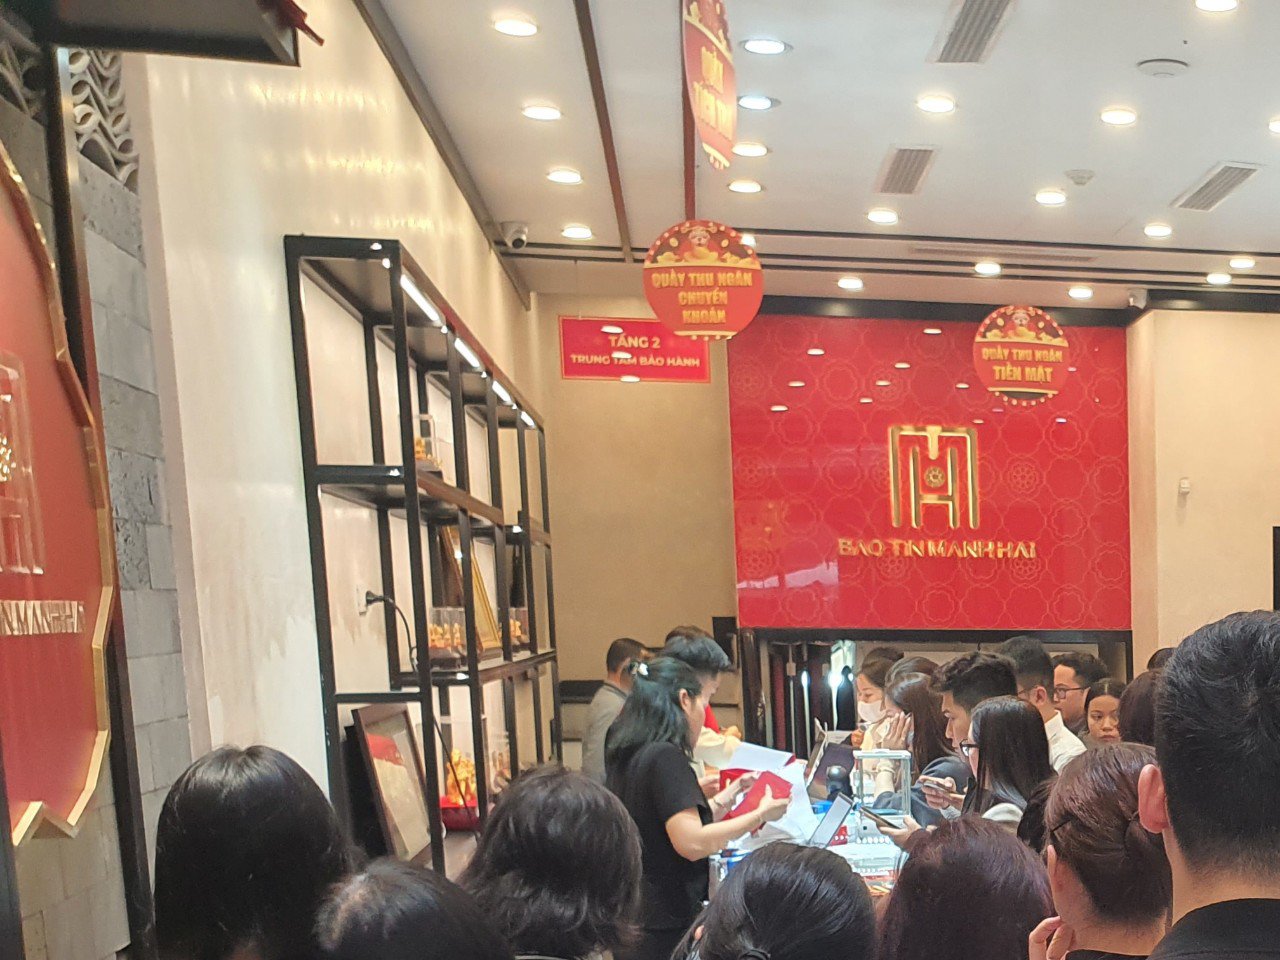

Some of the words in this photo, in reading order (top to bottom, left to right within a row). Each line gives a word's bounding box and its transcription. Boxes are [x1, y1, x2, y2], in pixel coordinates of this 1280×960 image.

[688, 272, 714, 287] THU
[717, 270, 753, 287] NGÂN
[651, 336, 661, 349] 2
[570, 353, 611, 365] TRUNG
[639, 353, 664, 366] BẢO
[1011, 348, 1033, 361] THU
[1034, 348, 1063, 362] NGÂN
[1024, 365, 1053, 384] MẶT
